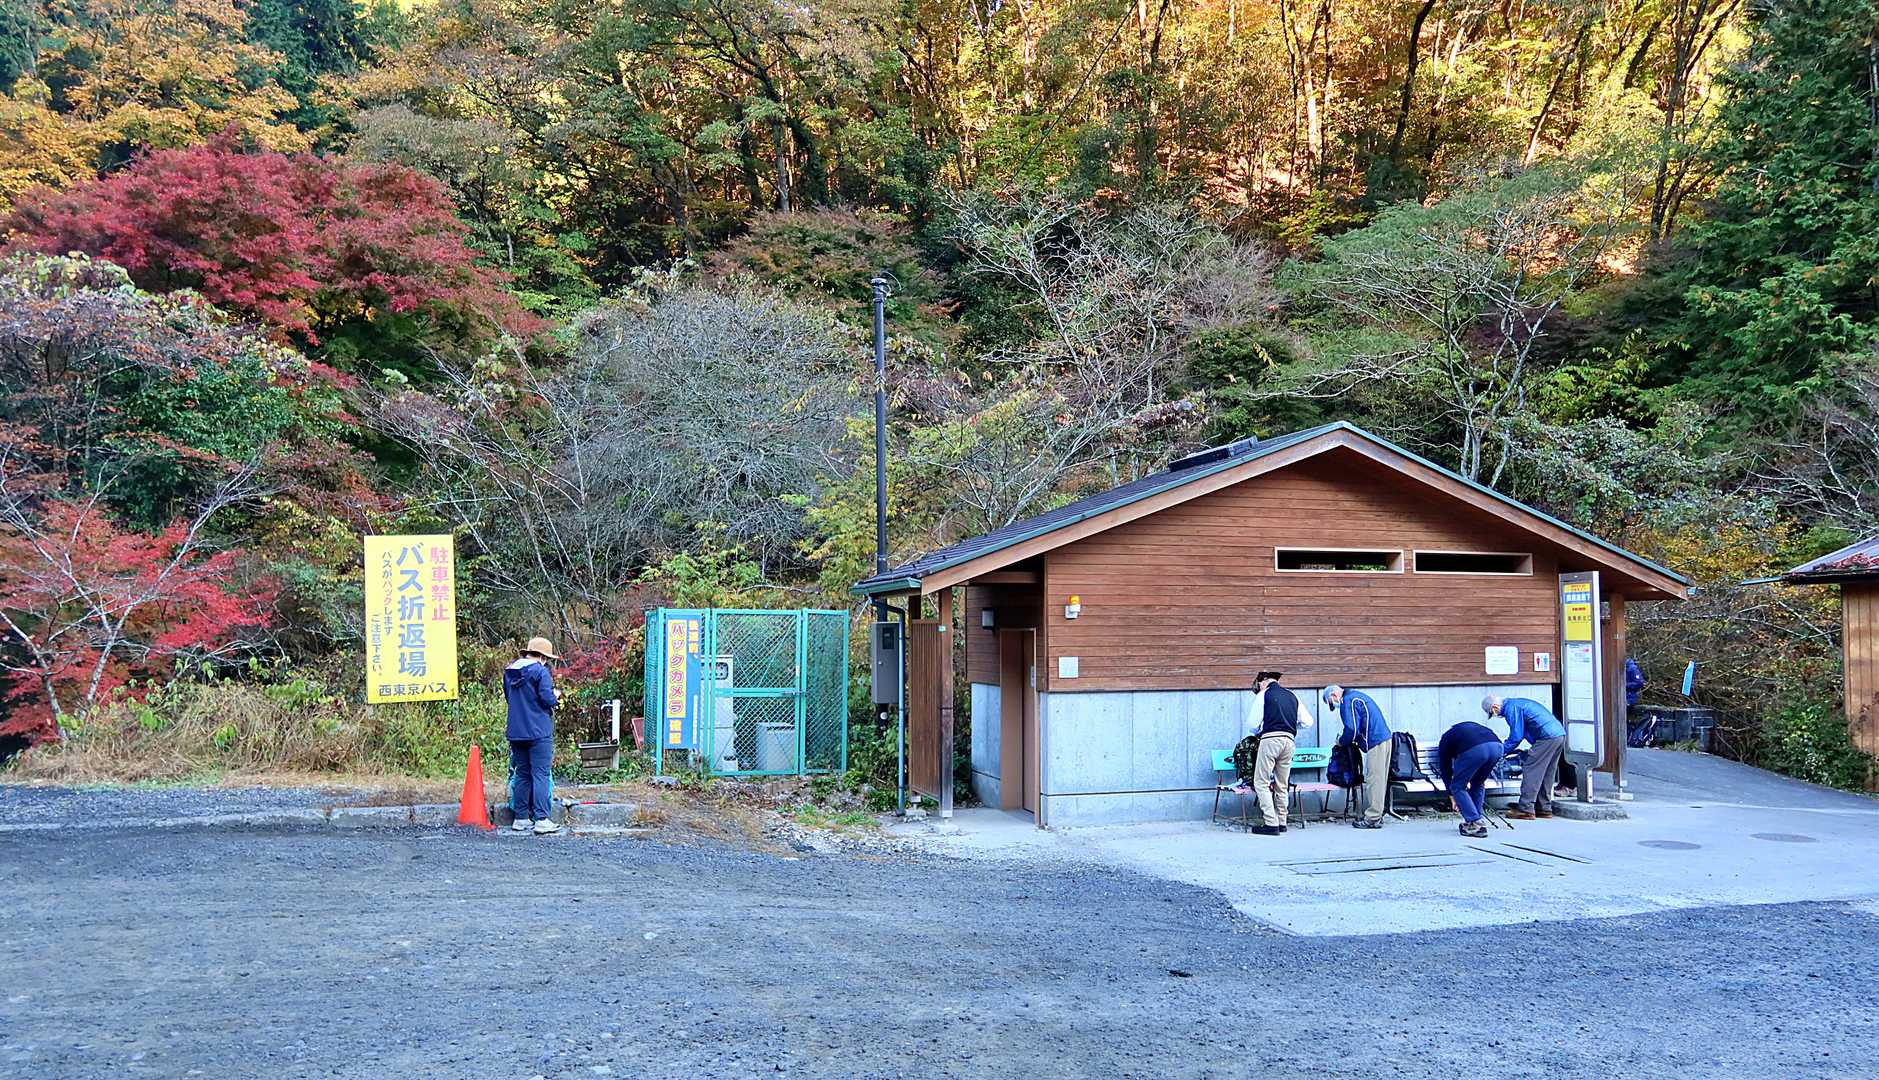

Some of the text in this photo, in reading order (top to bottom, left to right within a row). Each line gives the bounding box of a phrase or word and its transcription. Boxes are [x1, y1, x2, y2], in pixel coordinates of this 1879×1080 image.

[396, 542, 427, 678] バス折返場
[430, 546, 450, 621] 駐車禁止
[378, 682, 448, 697] 西東京バス
